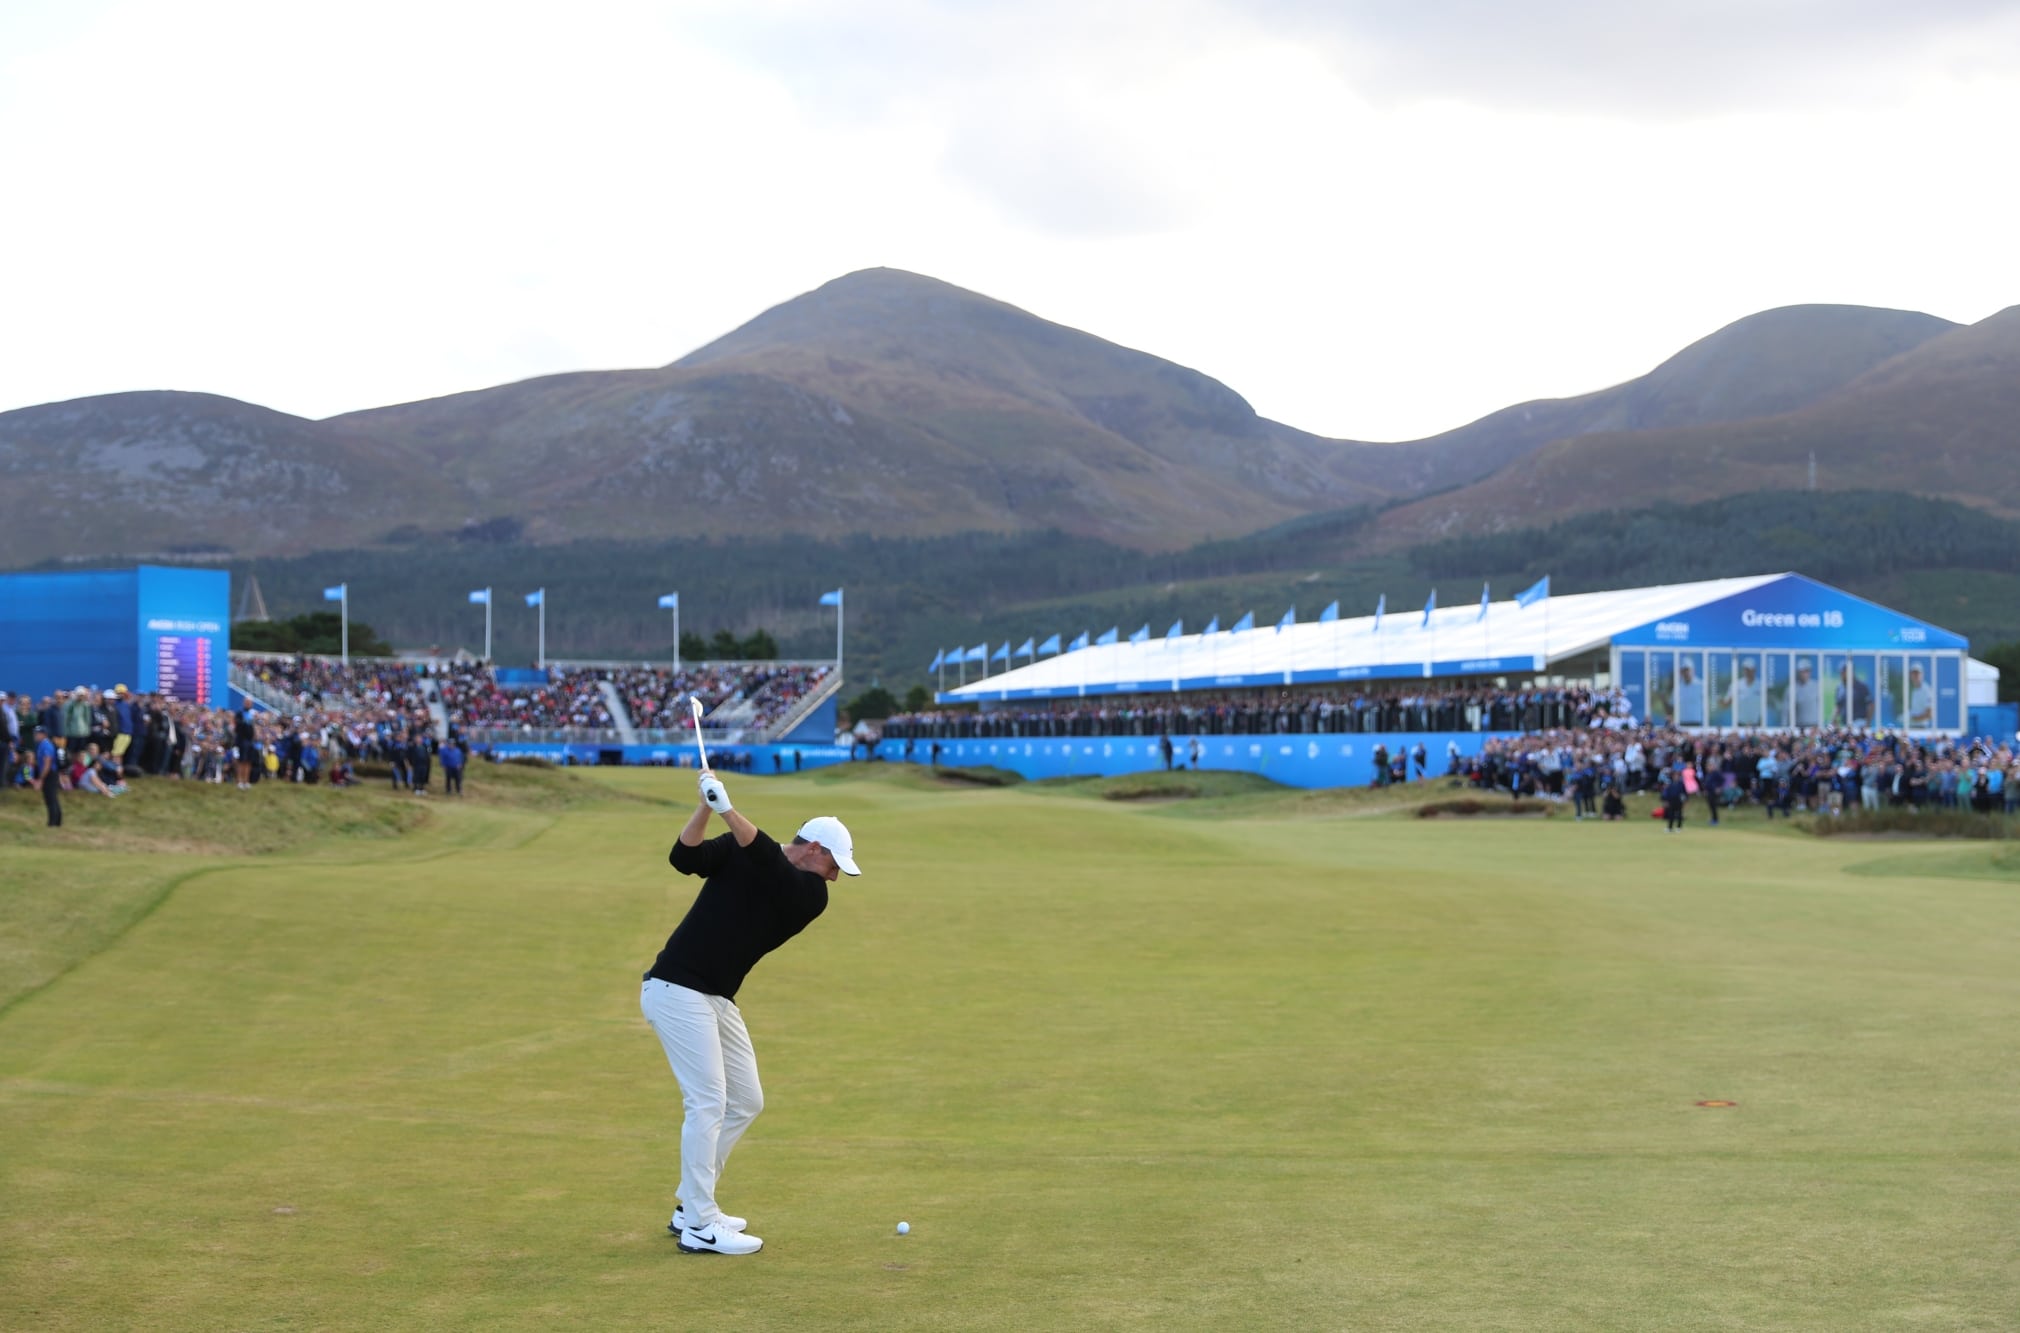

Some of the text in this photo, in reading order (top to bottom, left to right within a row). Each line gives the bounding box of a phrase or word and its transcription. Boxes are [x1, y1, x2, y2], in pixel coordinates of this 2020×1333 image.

[1742, 609, 1843, 628] Green on 18
